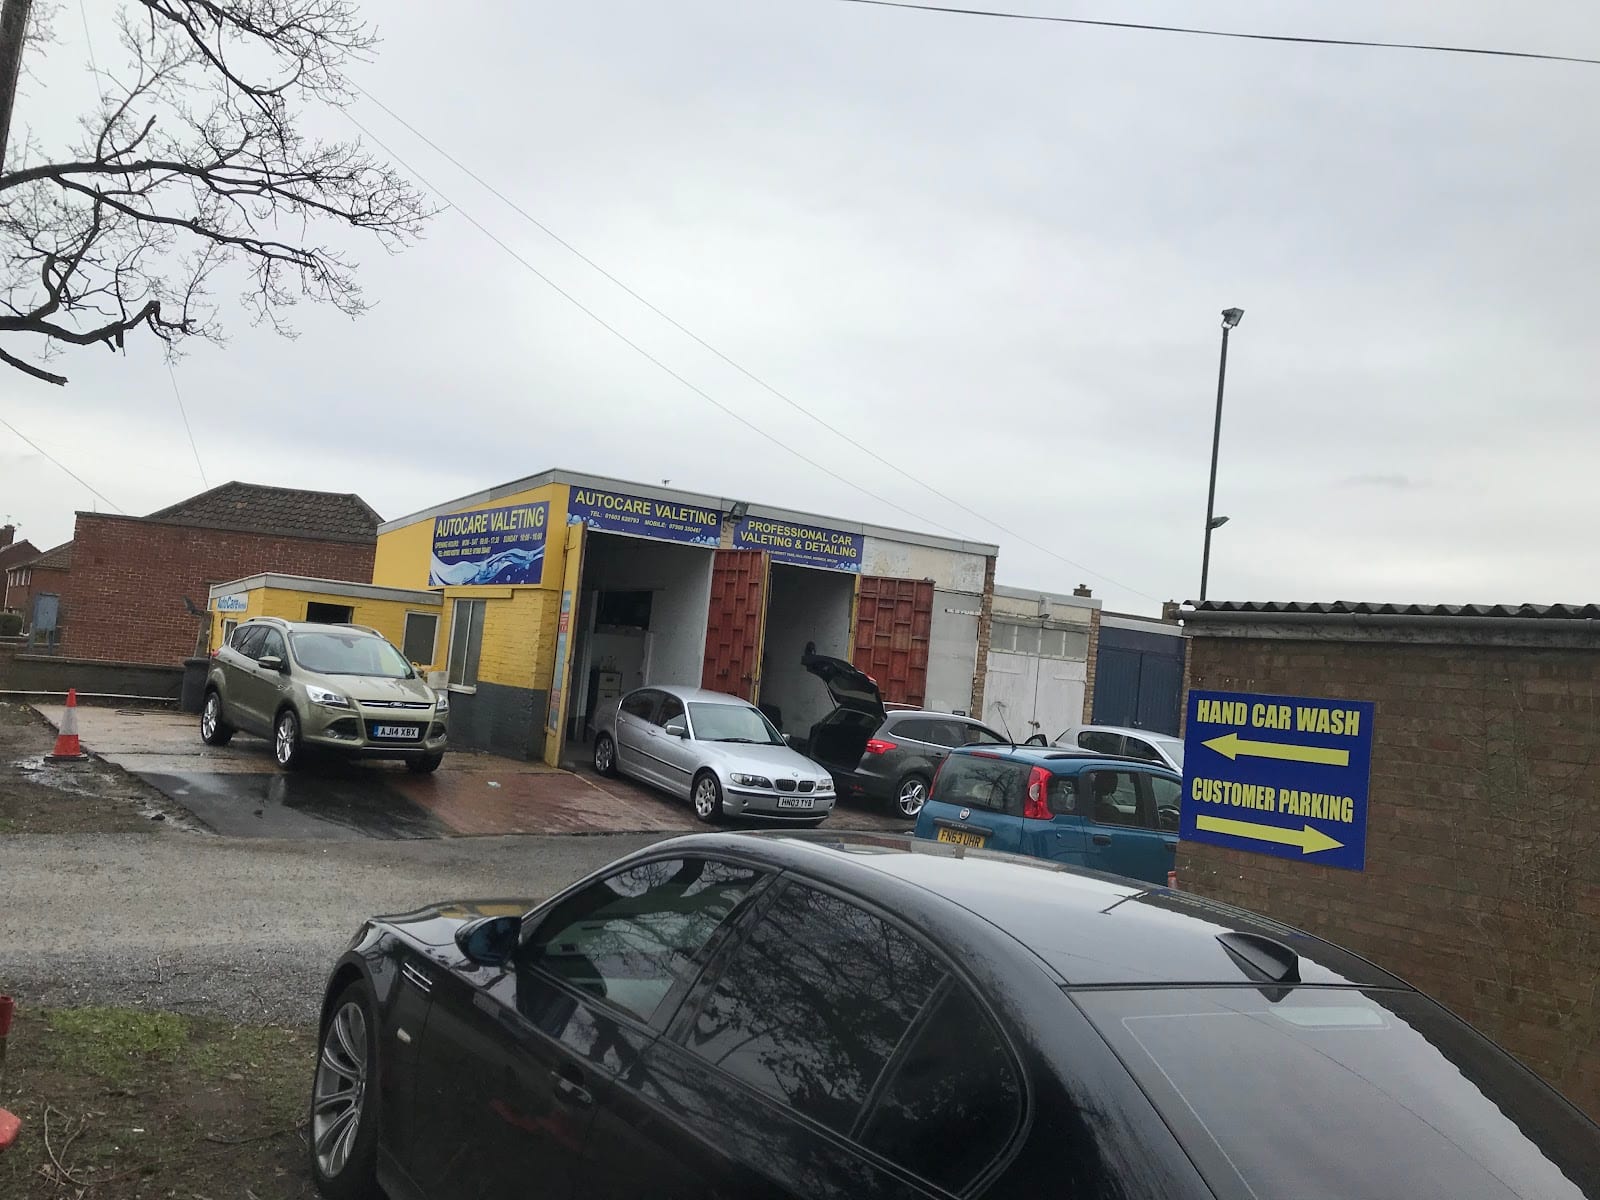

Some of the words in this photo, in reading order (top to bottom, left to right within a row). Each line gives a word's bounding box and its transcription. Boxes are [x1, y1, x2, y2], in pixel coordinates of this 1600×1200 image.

[436, 513, 489, 537] AUTOCARE
[490, 506, 545, 532] VALETING
[575, 490, 651, 515] AUTOCARE
[655, 503, 717, 526] VALETING
[740, 531, 792, 548] VALETING
[794, 539, 802, 550] &
[805, 541, 857, 558] DETAILING
[747, 520, 828, 542] PROFESSIONAL
[831, 533, 852, 546] CAR
[380, 727, 399, 736] AJ14
[400, 727, 416, 737] XBX
[1196, 699, 1248, 726] HAND
[1251, 703, 1292, 730] CAR
[1296, 706, 1360, 736] WASH
[1192, 777, 1275, 812] CUSTOMER
[1278, 788, 1354, 823] PARKING
[940, 829, 962, 844] FN63
[963, 834, 981, 847] UHR
